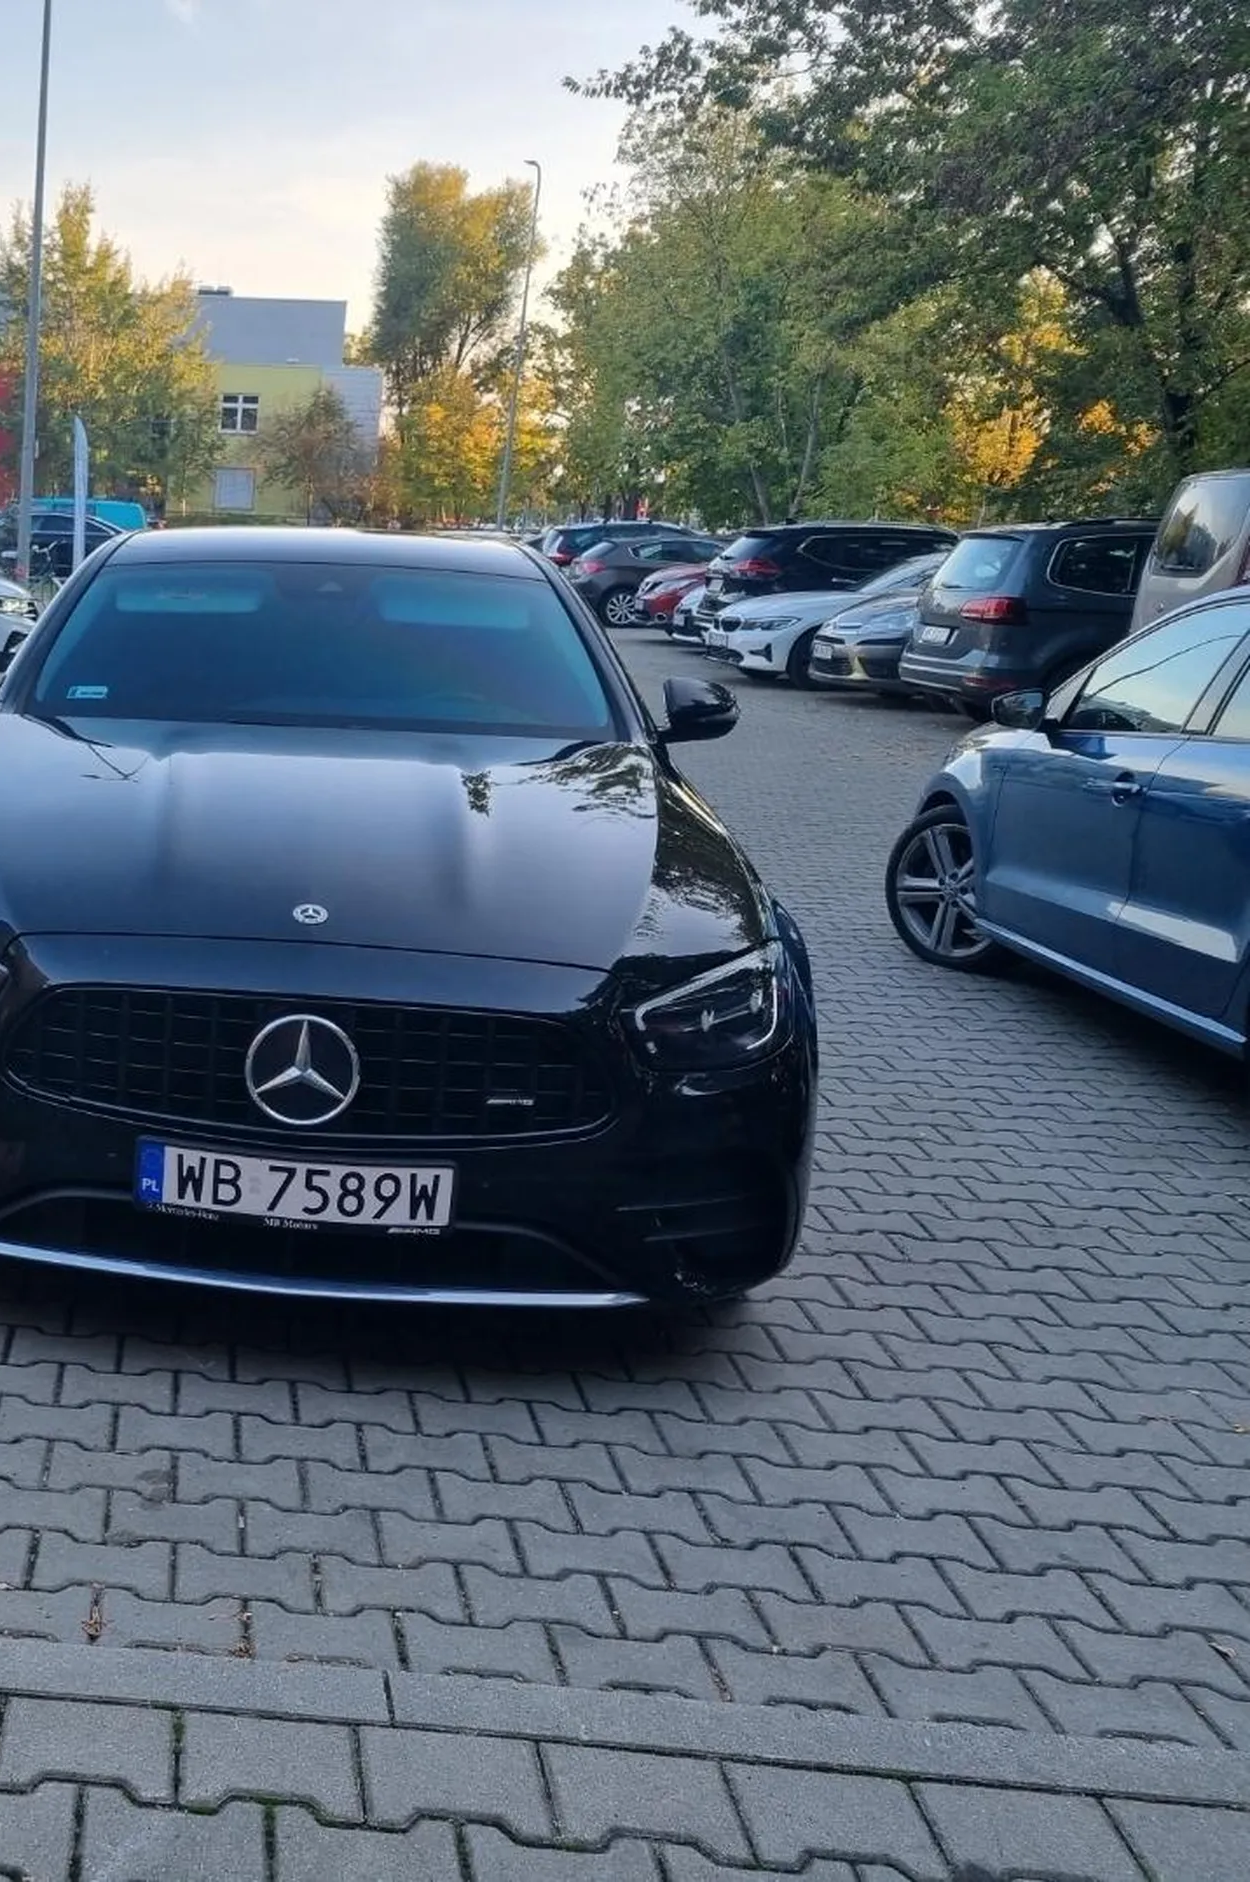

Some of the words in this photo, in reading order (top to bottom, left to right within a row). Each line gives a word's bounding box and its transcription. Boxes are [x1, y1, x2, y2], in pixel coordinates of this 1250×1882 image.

[142, 1178, 159, 1192] PL
[177, 1153, 243, 1206] WB
[267, 1165, 440, 1220] 7589W
